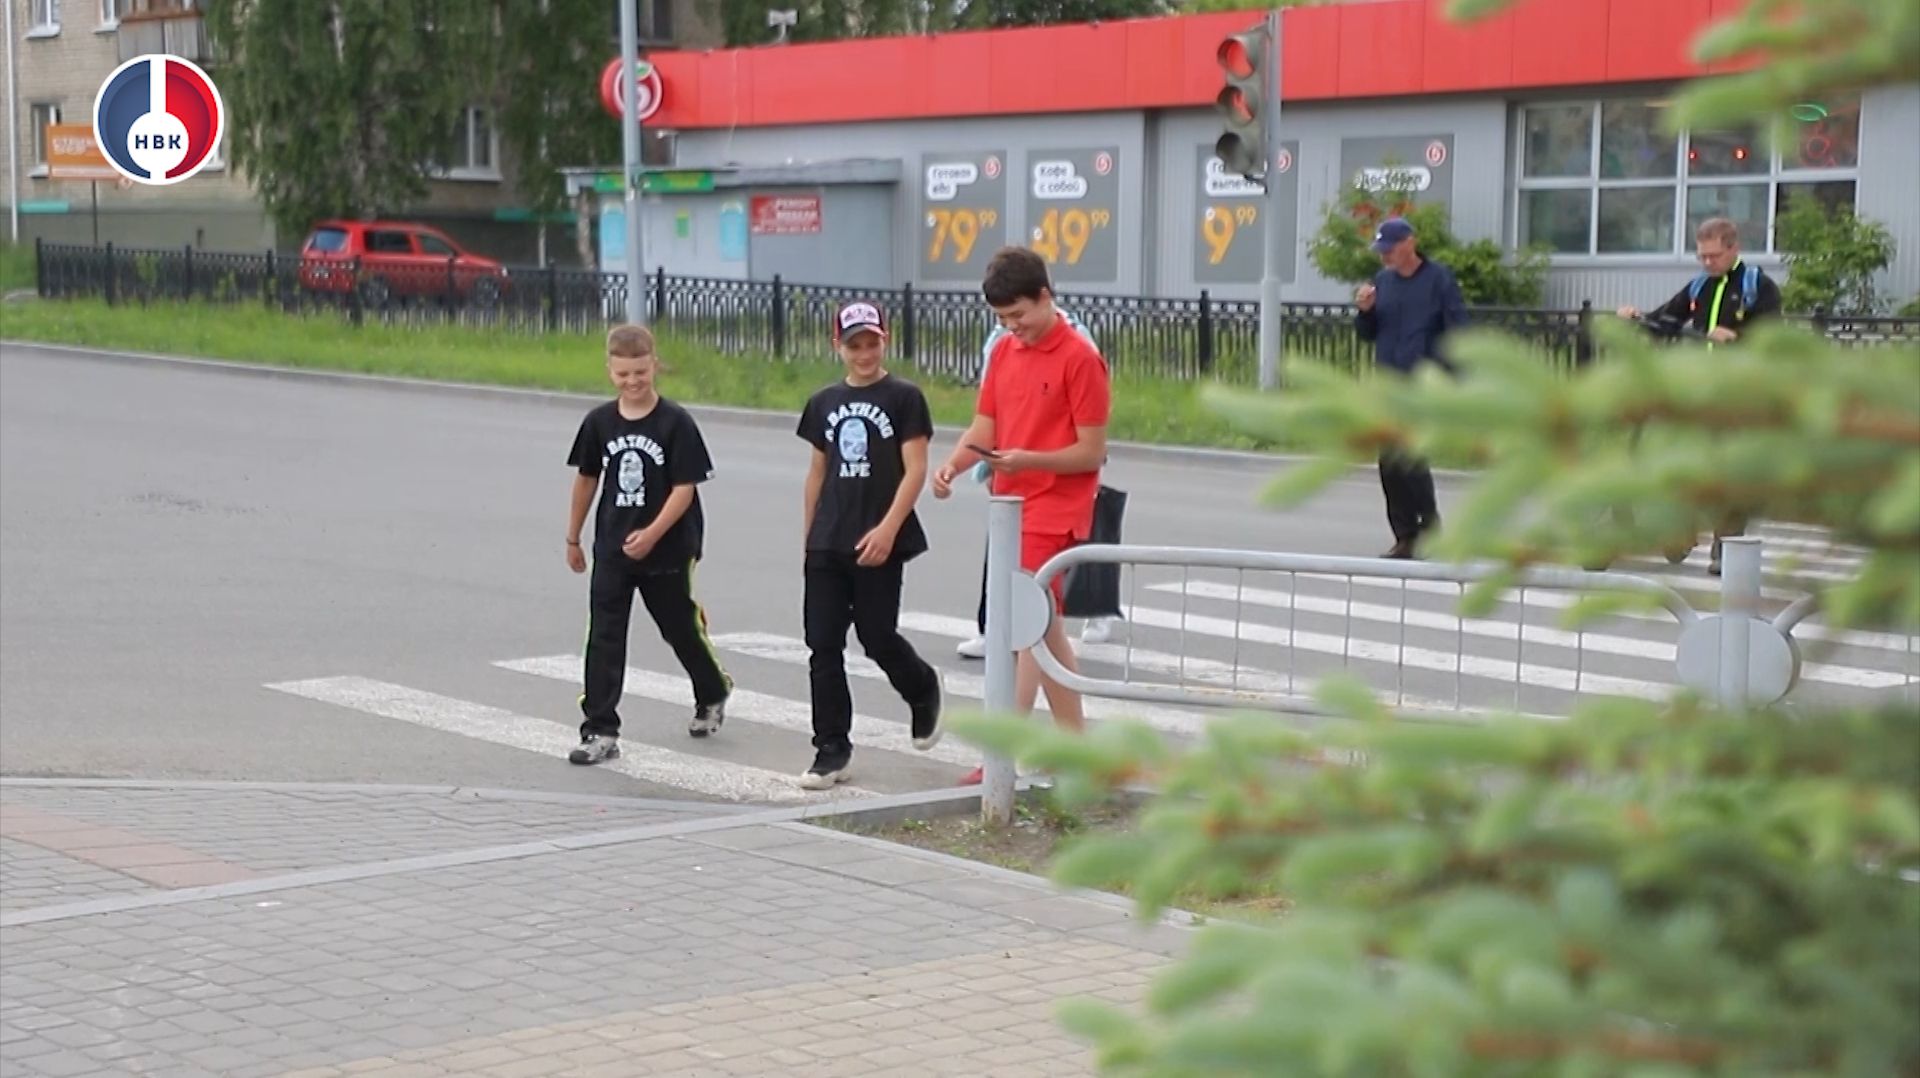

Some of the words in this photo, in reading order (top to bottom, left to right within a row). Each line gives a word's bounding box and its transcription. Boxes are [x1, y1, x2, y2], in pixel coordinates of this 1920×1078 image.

[932, 168, 972, 179] Готовая
[1040, 166, 1068, 178] Кофе
[932, 182, 952, 194] еда
[1048, 180, 1080, 192] собой
[928, 209, 977, 262] 79
[979, 210, 997, 228] 99
[1032, 208, 1088, 264] 49
[1091, 209, 1110, 229] 99
[1204, 206, 1234, 264] 9
[1236, 206, 1256, 225] 99
[826, 402, 894, 439] BATHING
[606, 434, 665, 465] BATHING
[839, 463, 871, 477] APE
[615, 492, 646, 507] APE
